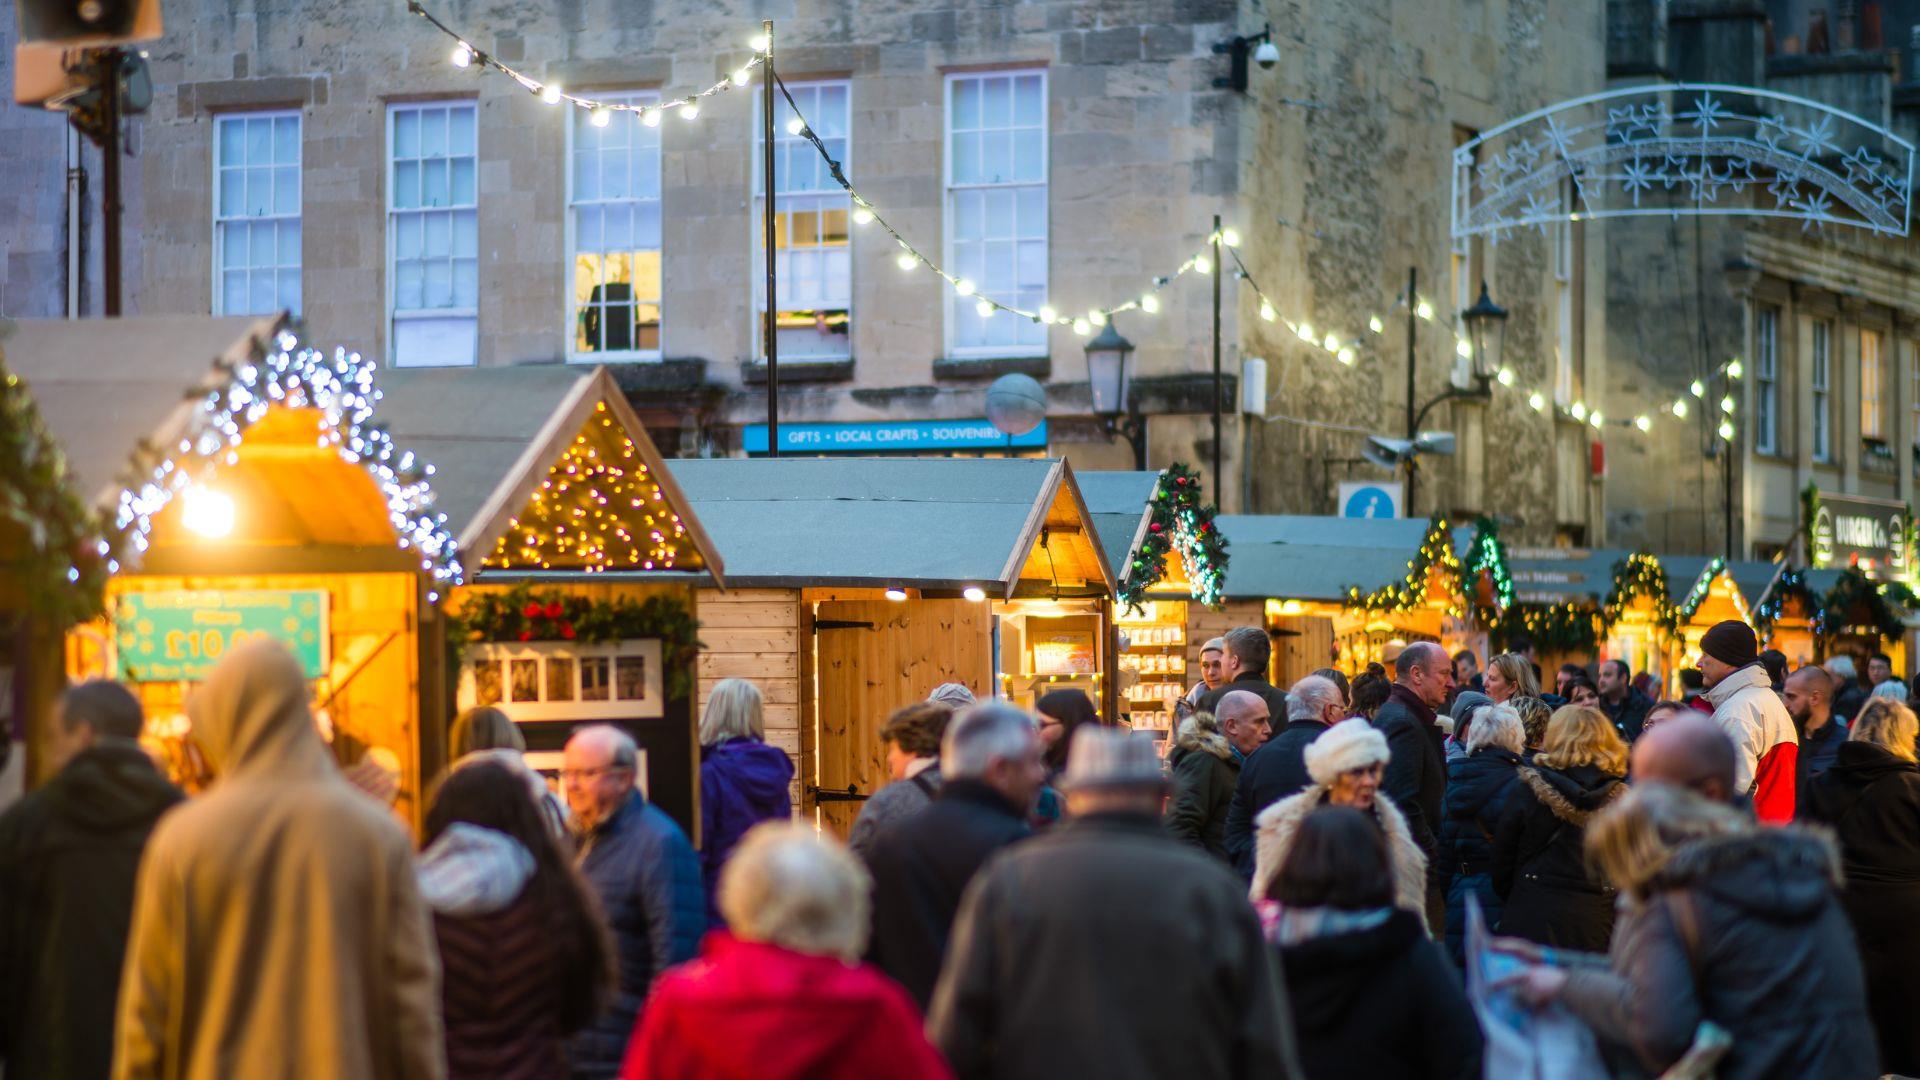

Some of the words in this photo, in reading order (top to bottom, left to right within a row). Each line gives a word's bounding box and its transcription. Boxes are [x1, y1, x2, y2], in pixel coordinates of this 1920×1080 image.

[788, 430, 821, 443] GIFTS
[835, 429, 873, 442] LOCAL
[876, 428, 919, 441] CRAFTS
[932, 426, 1001, 440] SOUVENIRS
[1836, 515, 1874, 547] BURGER
